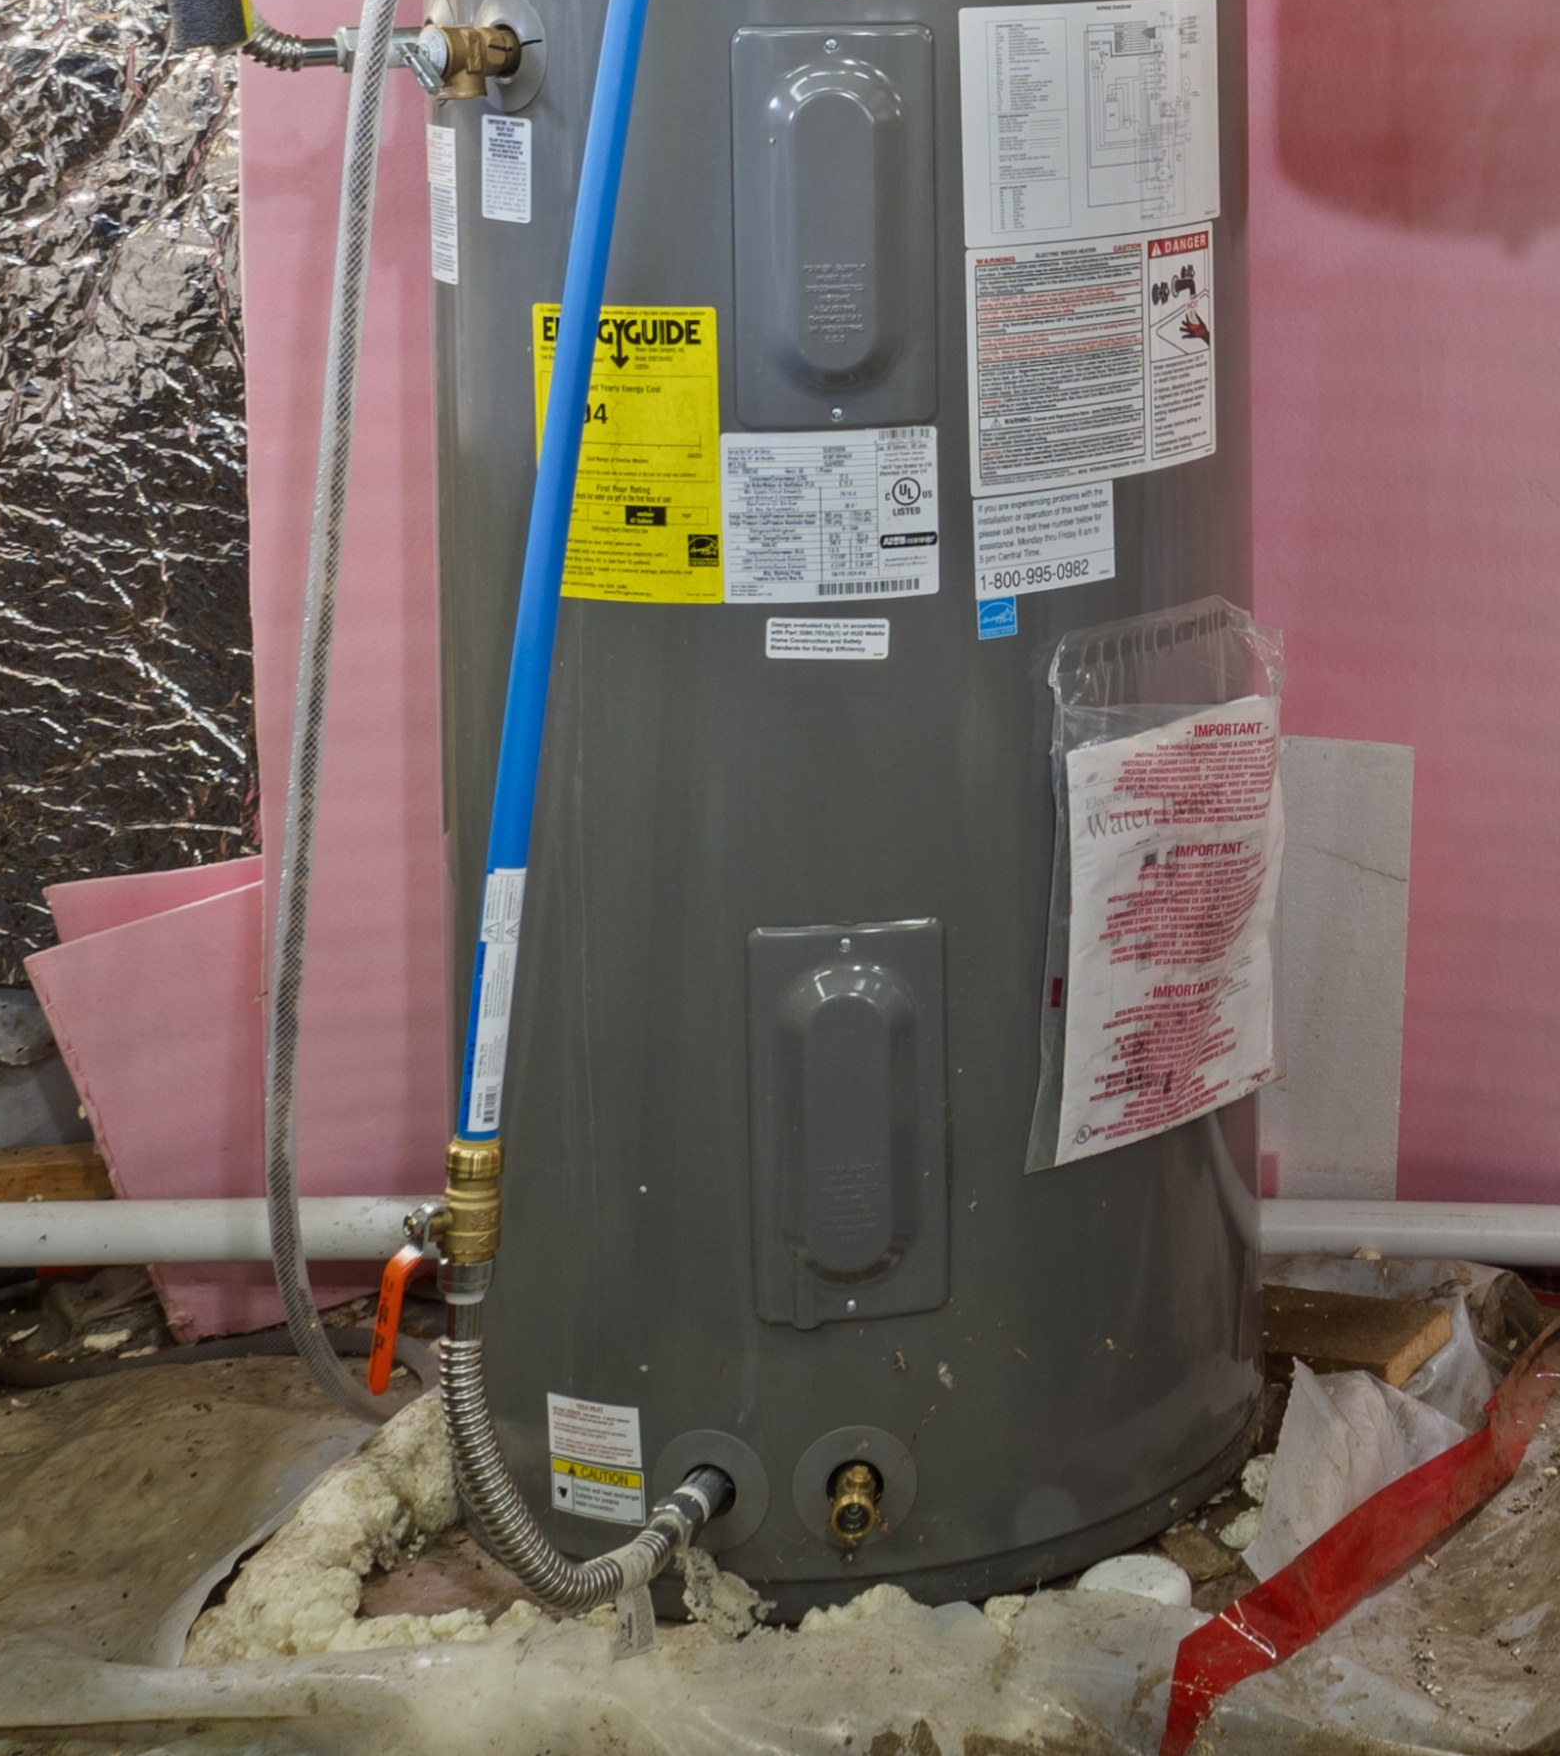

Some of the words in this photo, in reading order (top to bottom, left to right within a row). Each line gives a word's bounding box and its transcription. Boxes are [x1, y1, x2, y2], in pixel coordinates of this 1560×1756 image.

[976, 256, 1016, 265] WARNING
[1035, 251, 1060, 259] ELECTRIC
[1061, 249, 1078, 257] WATER
[1078, 247, 1097, 255] HEATER
[1113, 243, 1142, 253] CAUTION
[1164, 234, 1207, 254] DANGER
[1187, 301, 1199, 310] HOT
[543, 316, 701, 345] EGYGUIDE
[600, 384, 620, 393] Yearly
[622, 385, 644, 394] Energy
[596, 484, 611, 492] First
[630, 486, 651, 494] Rating
[984, 505, 997, 514] you
[1010, 498, 1051, 509] experiencing
[1052, 493, 1080, 505] problems
[1081, 490, 1093, 498] with
[1094, 488, 1103, 496] the
[892, 507, 920, 517] LISTED
[978, 514, 1013, 526] installation
[1023, 509, 1052, 521] operation
[1062, 505, 1072, 514] this
[1073, 503, 1089, 511] water
[1091, 500, 1109, 509] heater,
[978, 527, 1001, 540] please
[1002, 526, 1014, 536] call
[1016, 525, 1026, 534] the
[1038, 522, 1050, 531] free
[1052, 518, 1074, 528] number
[1076, 515, 1093, 525] below
[979, 540, 1014, 551] assistance.
[1018, 536, 1043, 547] Monday
[1045, 531, 1057, 541] thru
[1058, 529, 1076, 540] Friday
[985, 554, 997, 564] pm
[998, 551, 1022, 561] Central
[1024, 548, 1042, 557] Time.
[981, 559, 1089, 591] 1-800-995-0982
[1194, 722, 1263, 737] IMPORTANT
[1087, 805, 1153, 840] Water
[1175, 841, 1243, 858] IMPORTANT
[1153, 976, 1219, 999] IMPORTANTE
[581, 1466, 628, 1485] CAUTION
